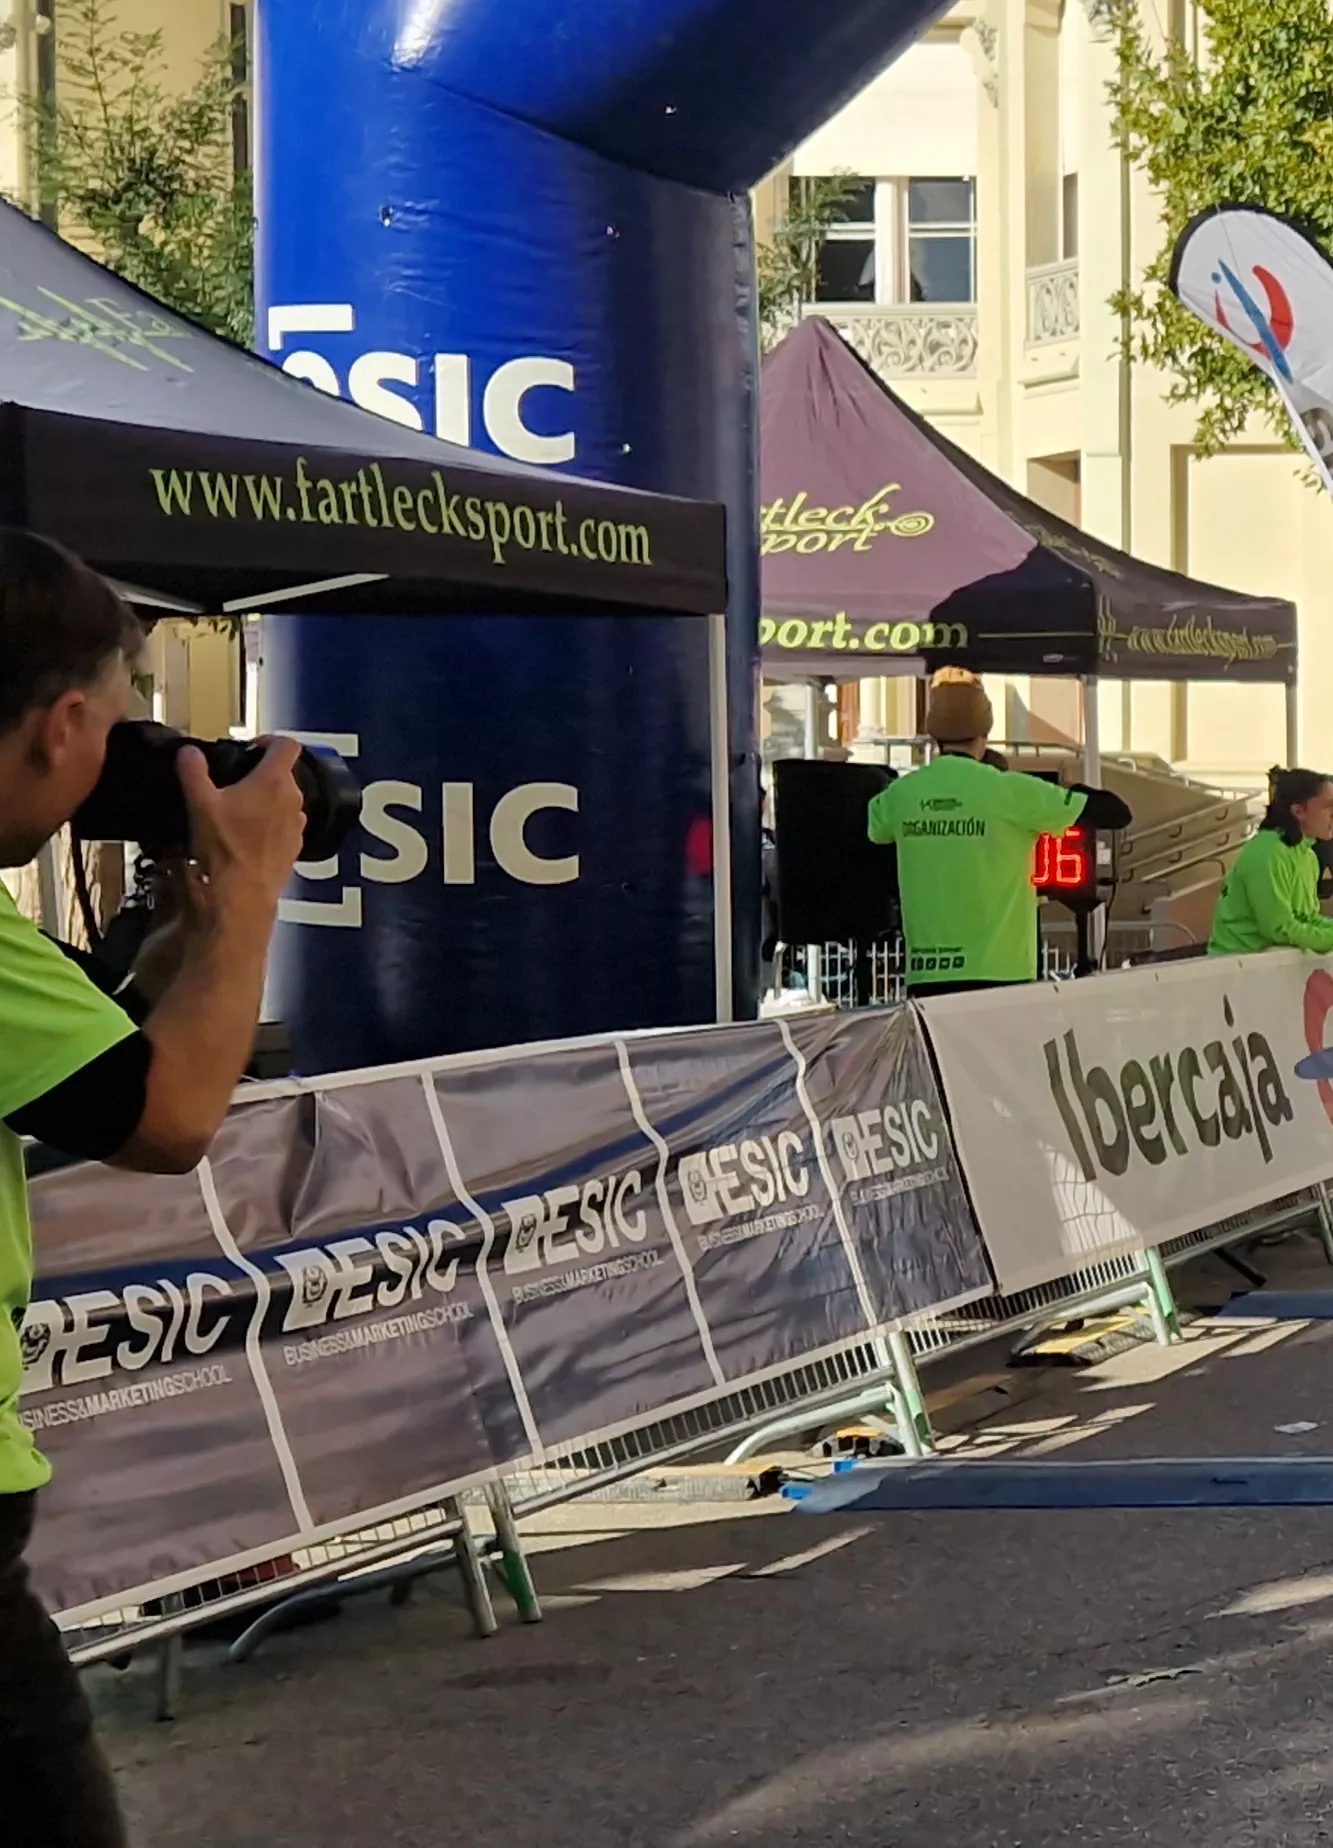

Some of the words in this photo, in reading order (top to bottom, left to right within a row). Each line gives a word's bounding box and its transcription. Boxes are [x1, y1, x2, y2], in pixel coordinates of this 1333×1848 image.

[150, 456, 653, 567] www.fartlecksport.com
[858, 1099, 939, 1174] ESIC
[1043, 994, 1295, 1184] Ibercaja
[541, 1169, 648, 1266] ESIC
[707, 1131, 811, 1216] ESIC
[333, 1218, 467, 1322] ESIC
[61, 1271, 236, 1387] ESIC
